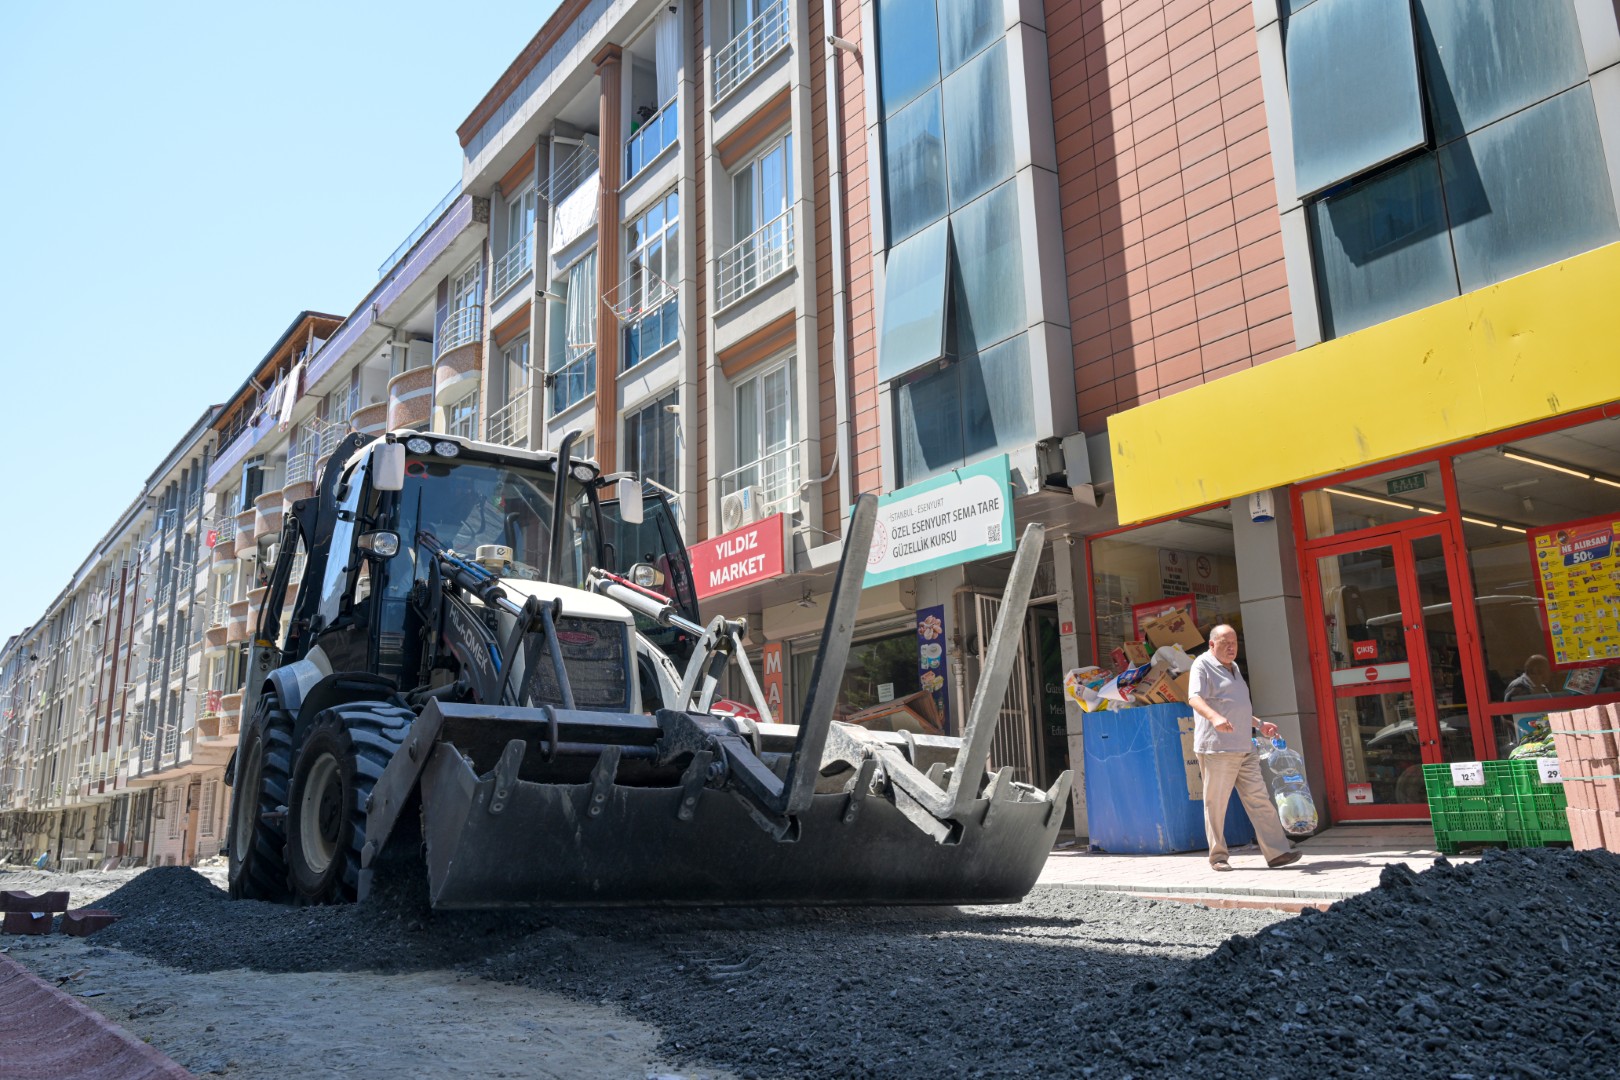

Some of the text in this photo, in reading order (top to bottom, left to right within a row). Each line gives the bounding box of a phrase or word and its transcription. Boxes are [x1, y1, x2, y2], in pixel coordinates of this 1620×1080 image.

[892, 498, 1000, 540] ÖZEL ESENYURT SEMA TARE
[917, 498, 944, 514] ESENYURT
[715, 530, 758, 560] YILDIZ
[893, 530, 957, 558] GÜZELLİK KURSU
[1561, 535, 1607, 553] NE ALIRSAN
[709, 554, 766, 588] MARKET
